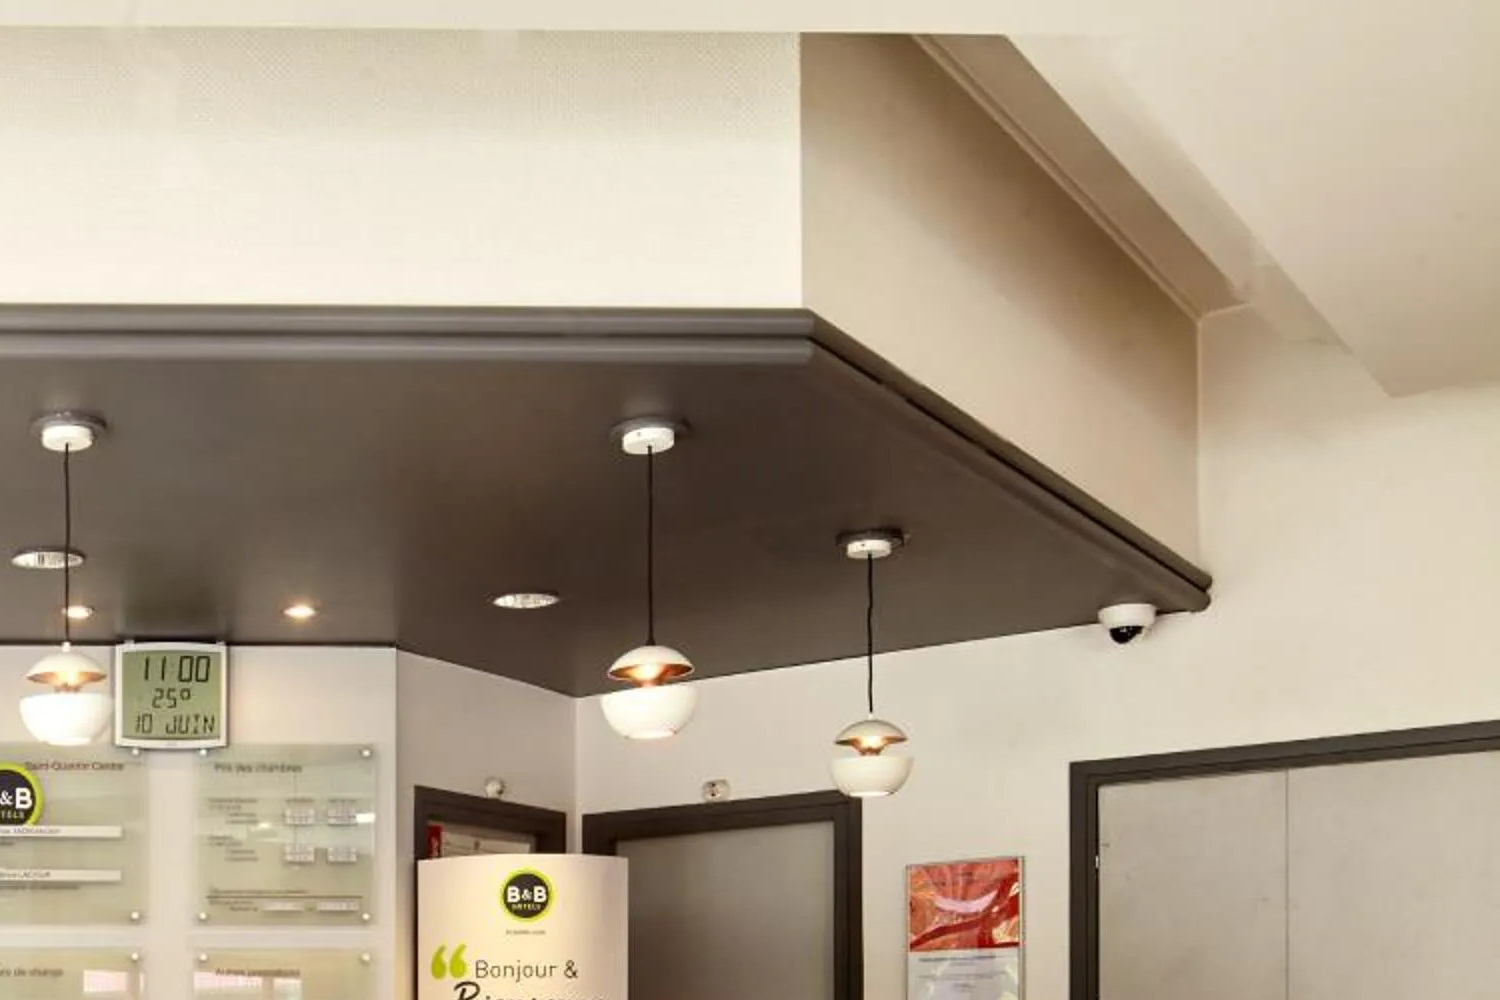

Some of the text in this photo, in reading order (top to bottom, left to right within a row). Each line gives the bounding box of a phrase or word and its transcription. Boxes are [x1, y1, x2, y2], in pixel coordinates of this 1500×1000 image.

[135, 713, 215, 734] 10 JUIN
[507, 886, 547, 902] B&B
[475, 960, 578, 982] Bonjour &
